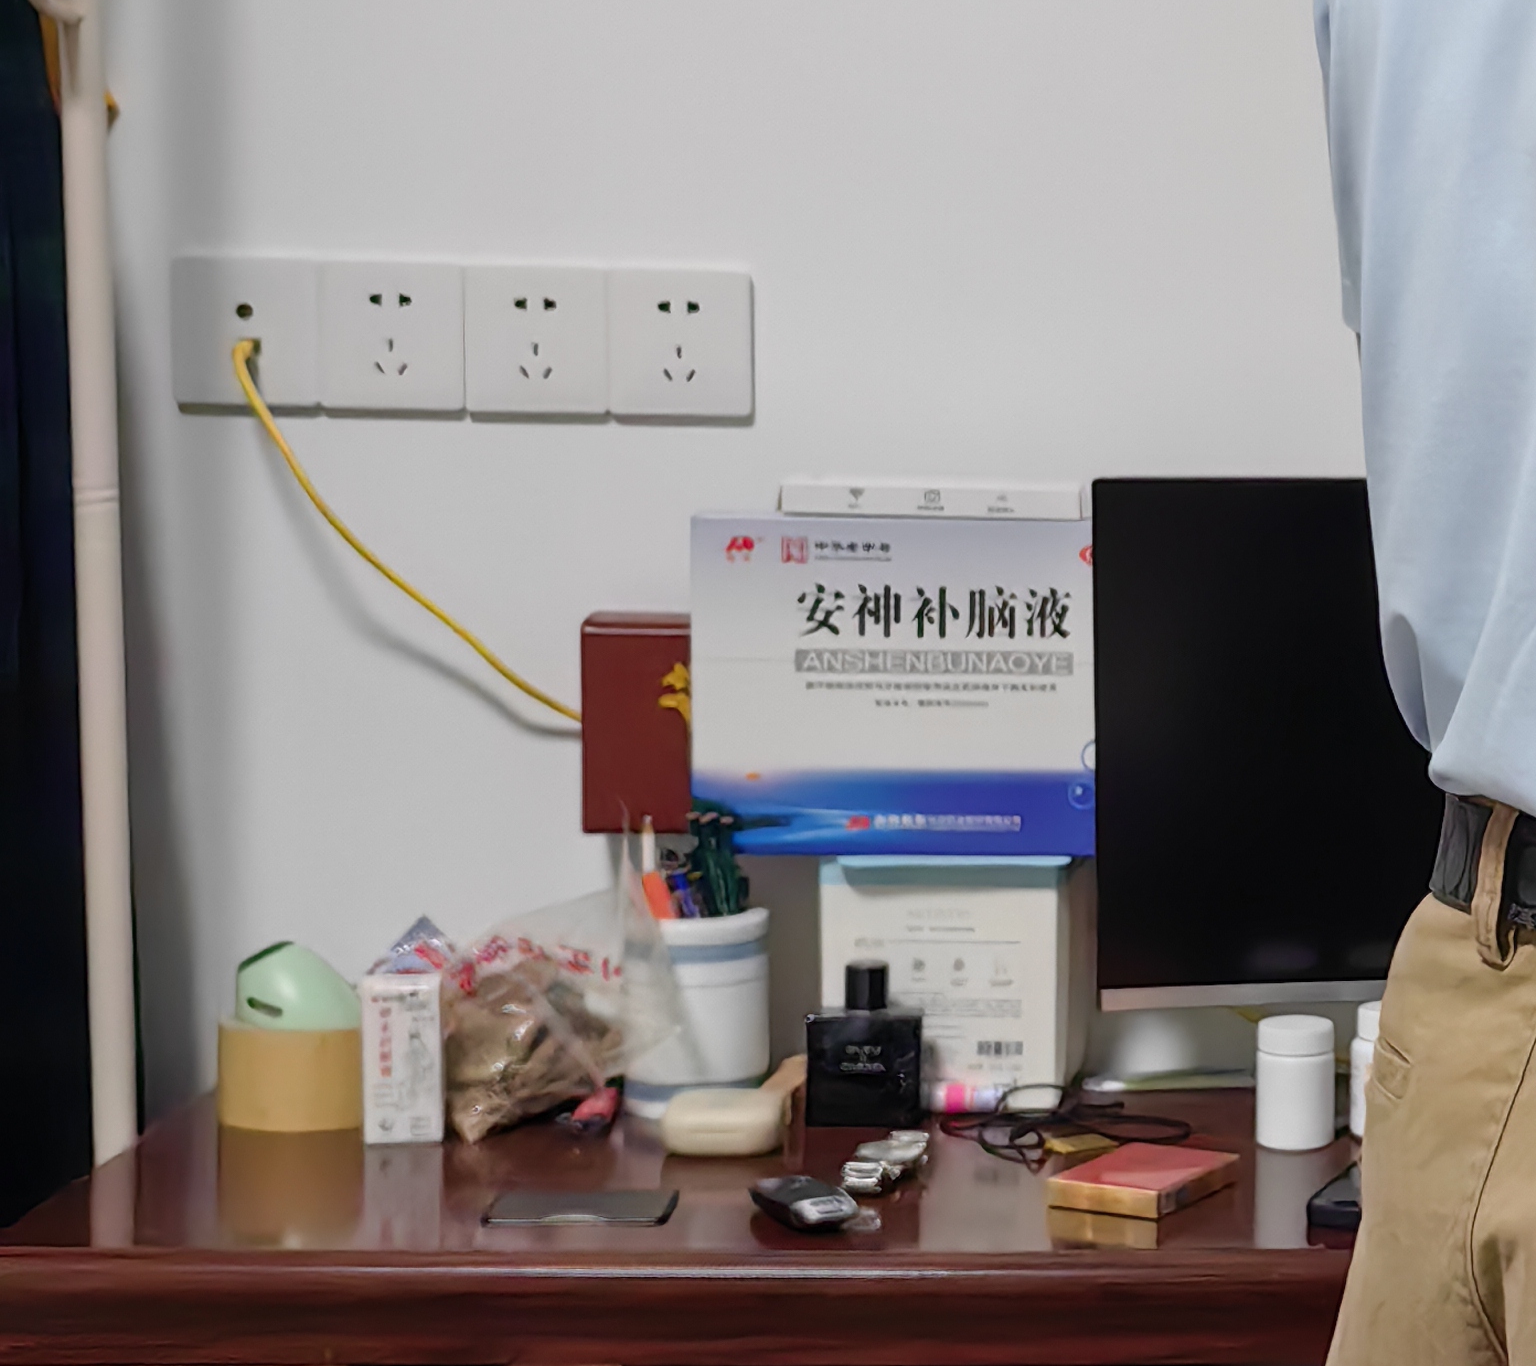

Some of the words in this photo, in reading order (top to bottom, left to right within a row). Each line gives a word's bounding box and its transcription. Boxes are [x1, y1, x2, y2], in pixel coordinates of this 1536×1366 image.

[797, 582, 1072, 639] 安神补脑液
[802, 651, 1070, 674] ANSHENBUNAOYE
